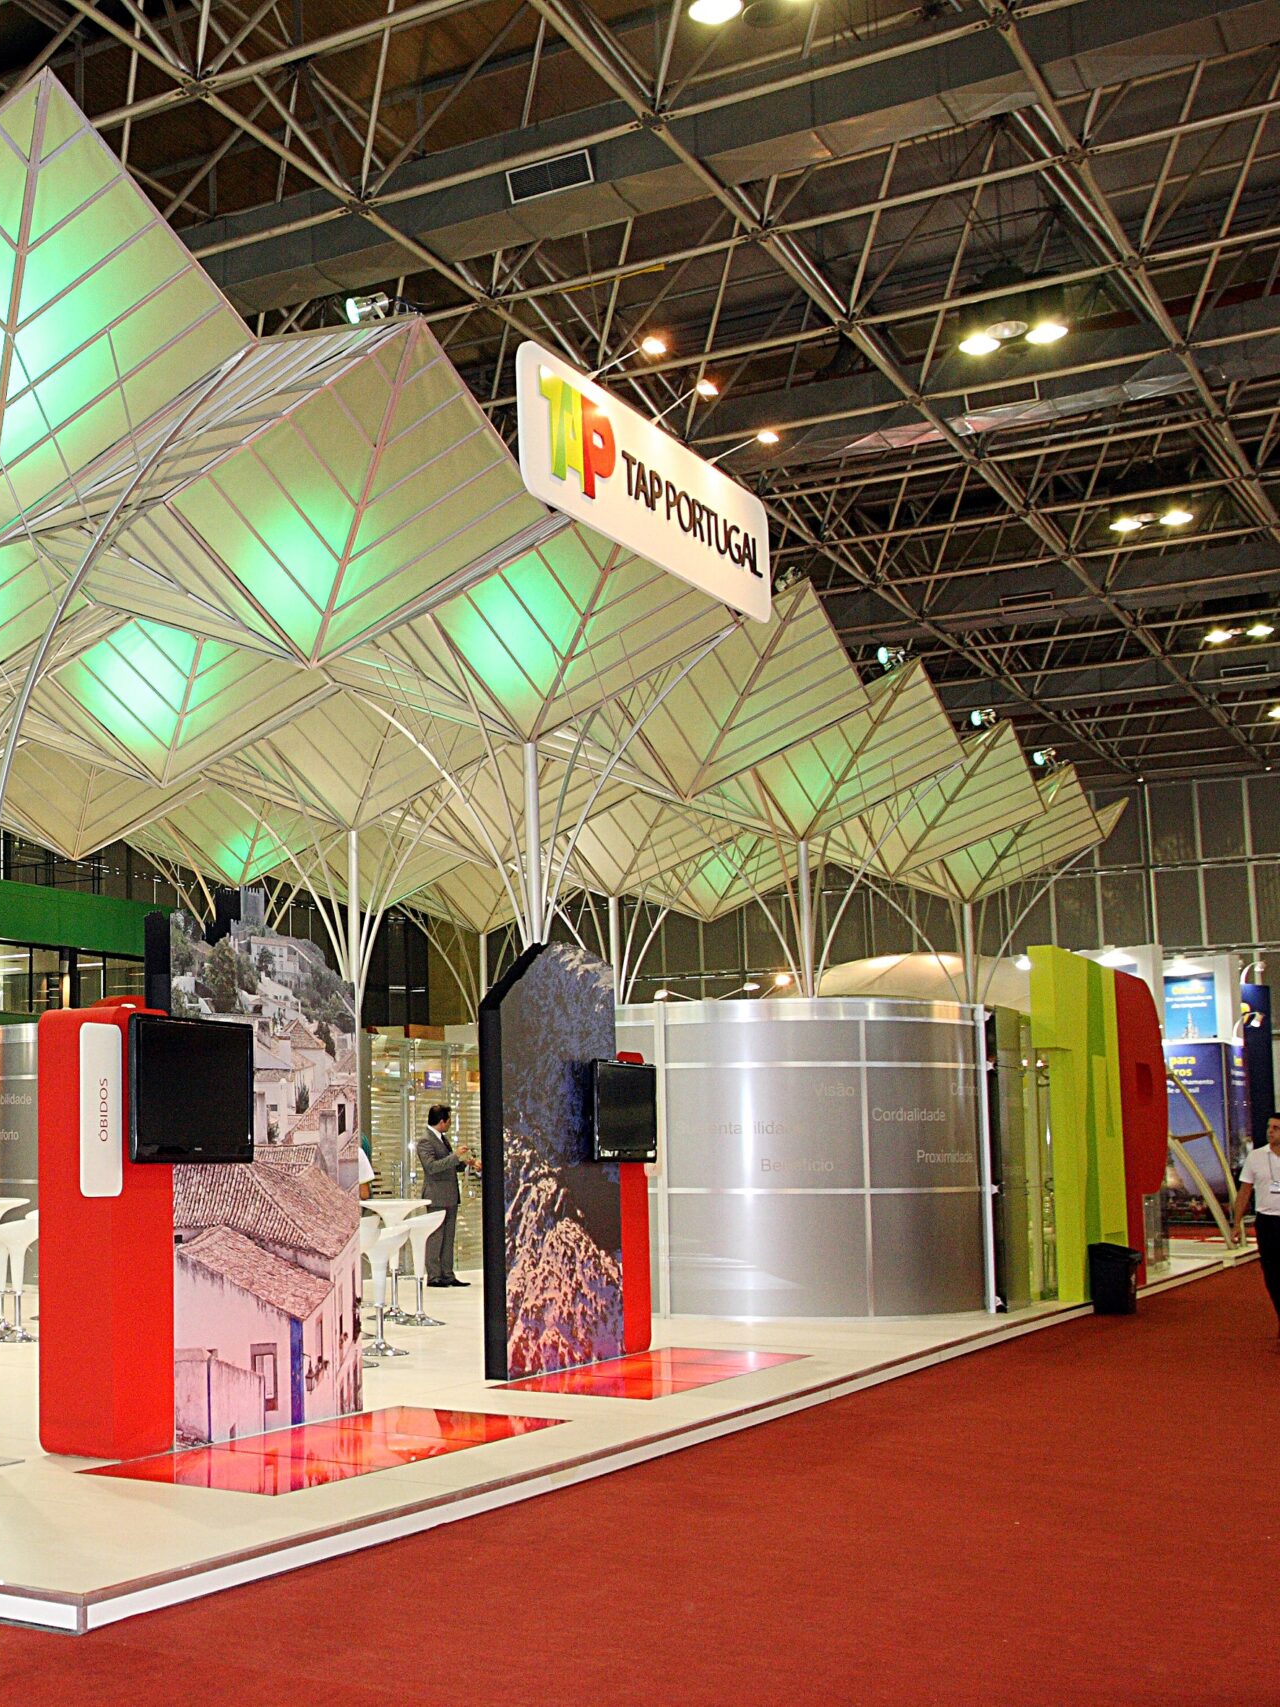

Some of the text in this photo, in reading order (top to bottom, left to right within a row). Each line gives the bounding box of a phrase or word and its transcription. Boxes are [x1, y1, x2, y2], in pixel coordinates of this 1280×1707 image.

[539, 364, 616, 499] TAP
[622, 450, 763, 579] TAP PORTUGAL
[98, 1078, 108, 1142] ÓBIDOS
[872, 1107, 946, 1121] Cordialidade
[917, 1150, 974, 1163] Proximidade
